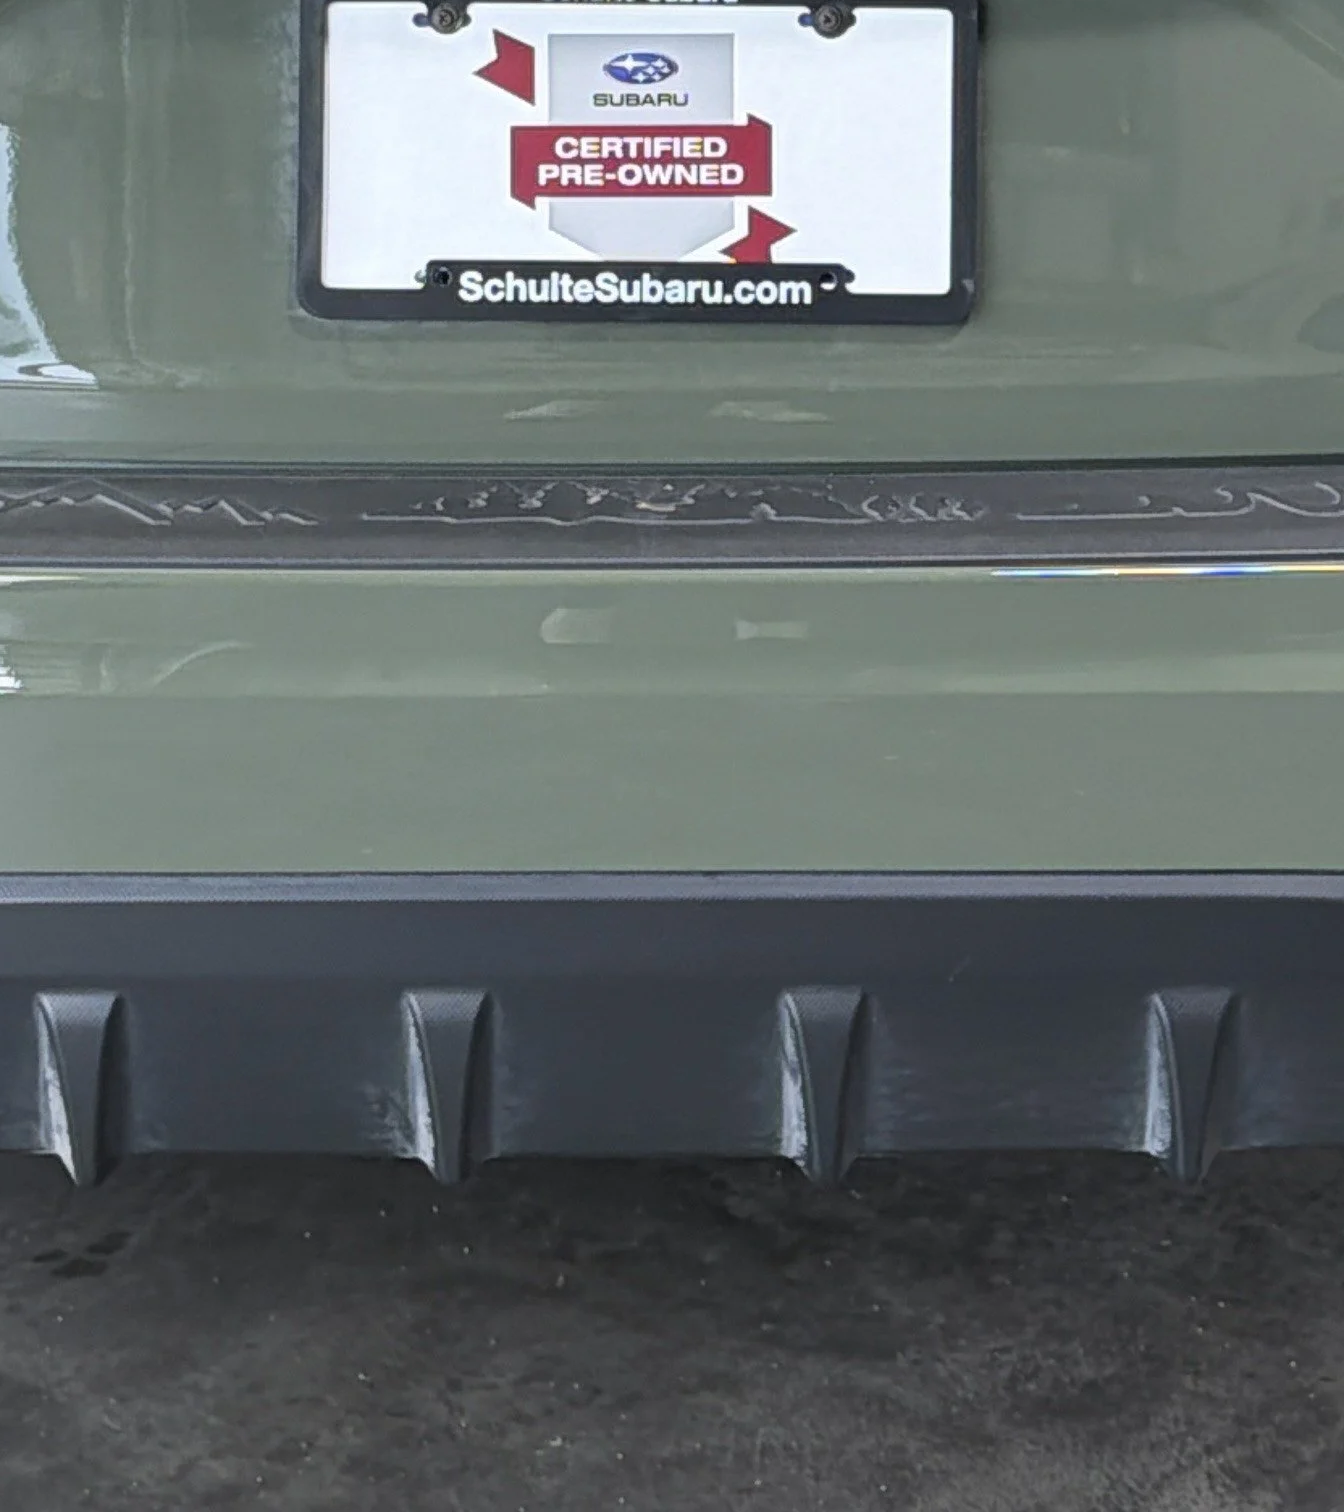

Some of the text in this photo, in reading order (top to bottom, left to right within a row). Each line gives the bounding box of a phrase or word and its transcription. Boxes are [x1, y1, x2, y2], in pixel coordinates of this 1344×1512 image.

[592, 92, 689, 108] SUBARU
[554, 136, 727, 160] CERTIFIED
[537, 163, 744, 186] PRE-OWNED
[457, 269, 813, 307] SchulteSubaru.com
